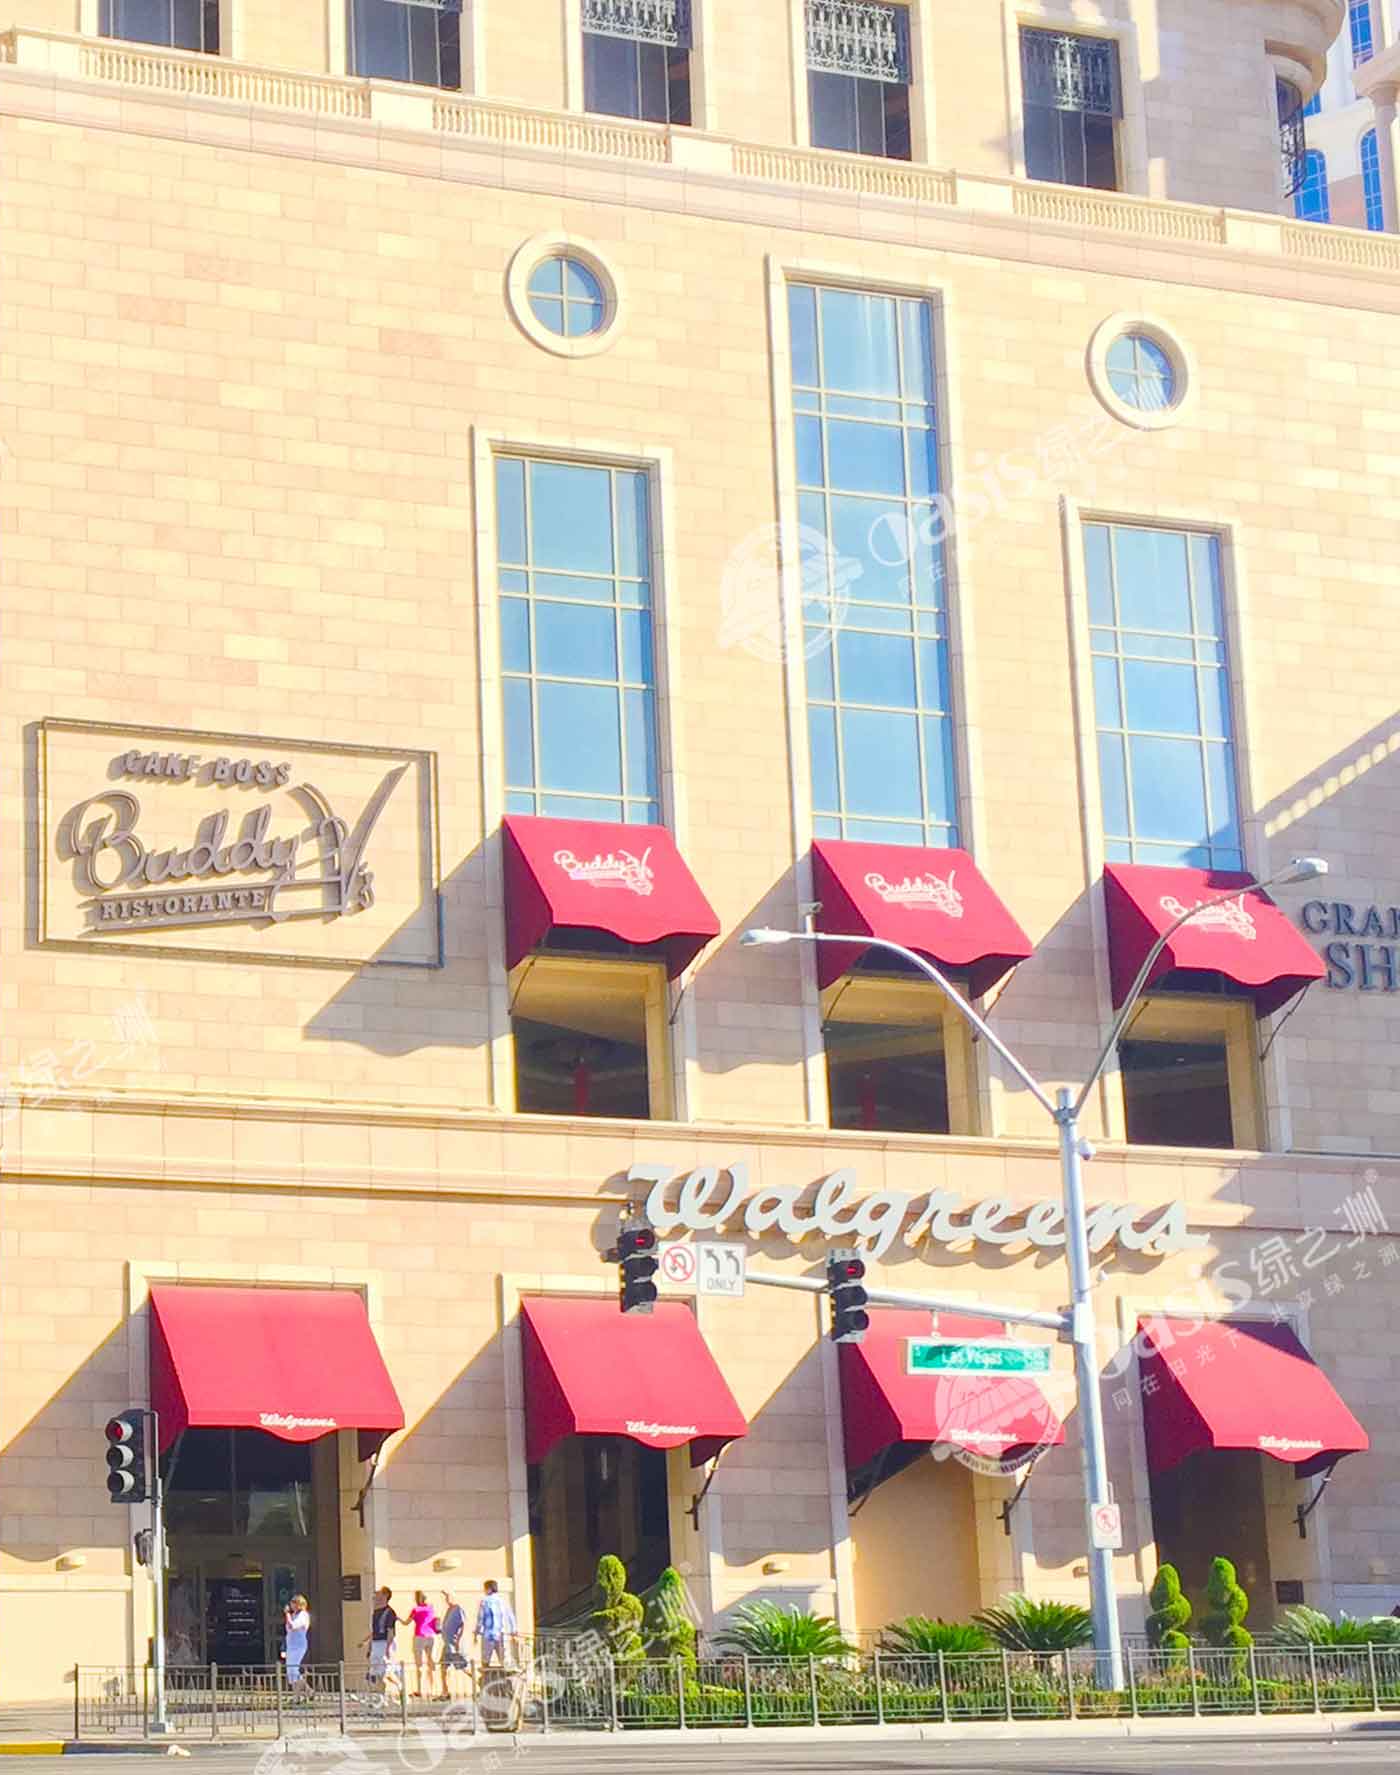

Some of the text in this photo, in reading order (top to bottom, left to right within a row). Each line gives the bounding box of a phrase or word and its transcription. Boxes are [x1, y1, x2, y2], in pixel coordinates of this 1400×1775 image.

[119, 748, 293, 787] CAKE BOSS
[66, 790, 302, 900] Buddy
[100, 888, 267, 921] RISTORANTE
[628, 1160, 1211, 1260] Walgreens
[706, 1277, 737, 1291] ONLY
